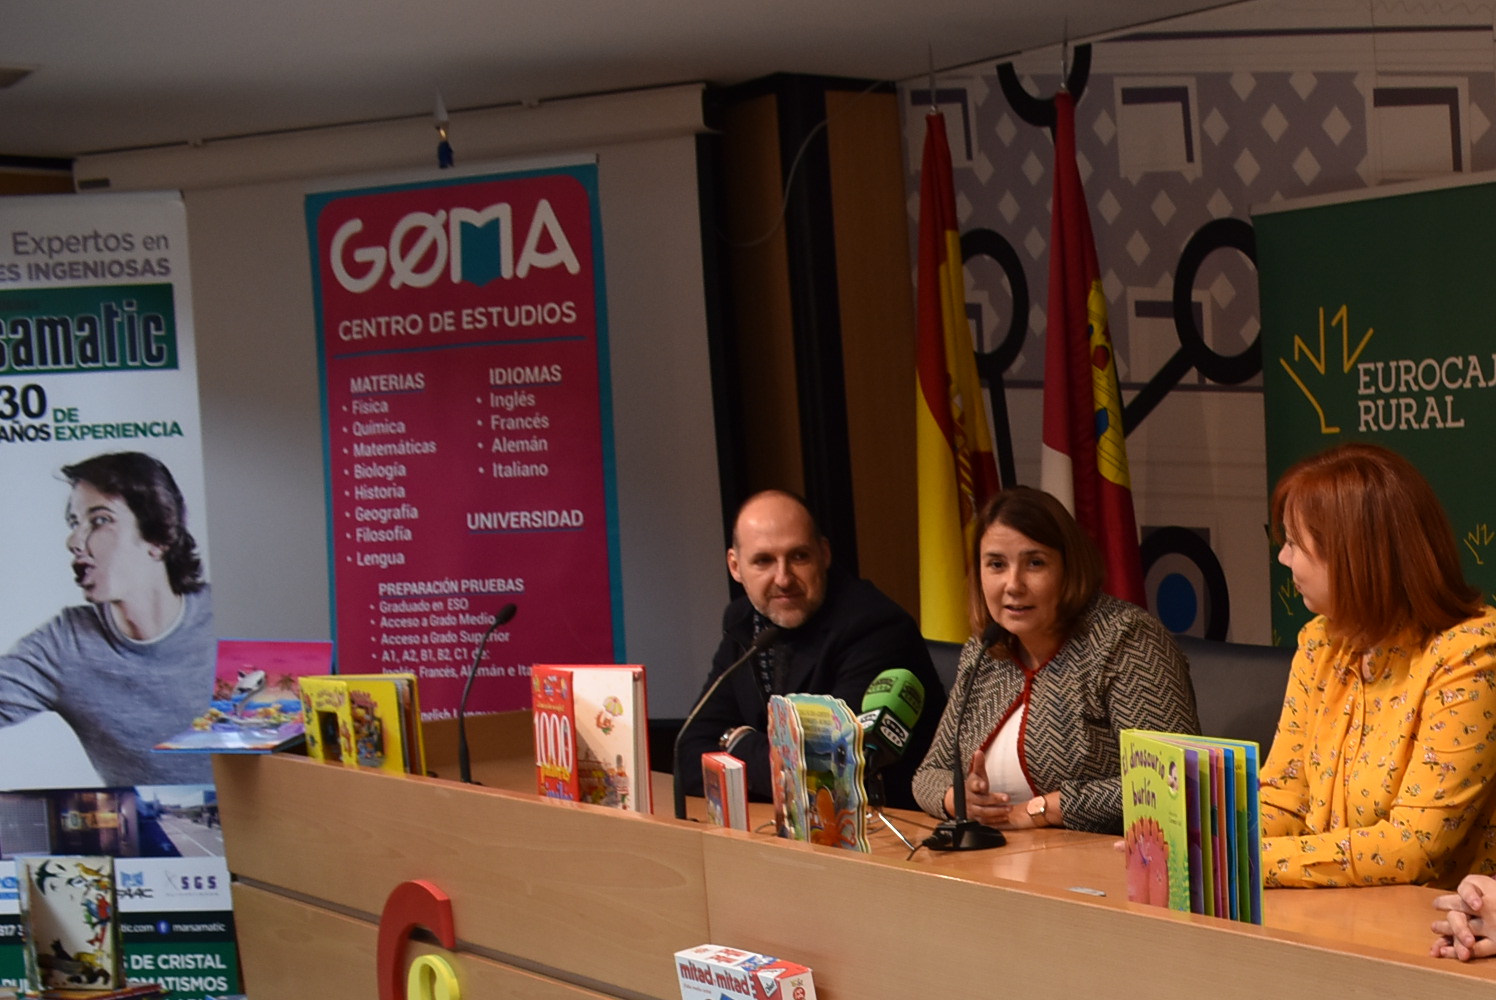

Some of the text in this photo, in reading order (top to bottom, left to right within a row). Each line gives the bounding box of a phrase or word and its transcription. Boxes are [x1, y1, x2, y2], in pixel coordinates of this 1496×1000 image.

[12, 230, 169, 258] Expertos en
[28, 258, 171, 281] INGENIOSAS
[339, 301, 577, 341] CENTRO DE ESTUDIOS
[350, 372, 425, 394] MATERIAS
[489, 365, 562, 386] IDIOMAS
[0, 384, 47, 420] 30
[490, 391, 536, 411] Inglés
[53, 408, 79, 423] DE
[490, 414, 550, 431] Francés
[1358, 395, 1465, 432] RURAL
[0, 420, 184, 442] AÑOS EXPERIENCIA
[353, 438, 437, 457] Matemáticas
[491, 435, 548, 453] Alemán
[492, 461, 549, 479] Italiano
[354, 484, 406, 500] Historia
[354, 503, 419, 524] Geografía
[466, 509, 584, 530] UNIVERSIDAD
[355, 525, 413, 543] Filosofía
[356, 551, 405, 569] Lengua
[378, 577, 525, 596] PREPARACIÓN PRUEBAS
[379, 598, 469, 613] Graduado en ESO
[380, 612, 496, 628] Acceso a Grado Medio
[381, 630, 510, 645] Acceso a Grado Suprior
[508, 667, 516, 676] e
[534, 710, 573, 773] 1000
[181, 876, 217, 890] SGS
[130, 954, 227, 970] DE CRISTAL
[679, 962, 713, 986] mitad
[715, 970, 751, 996] mitad
